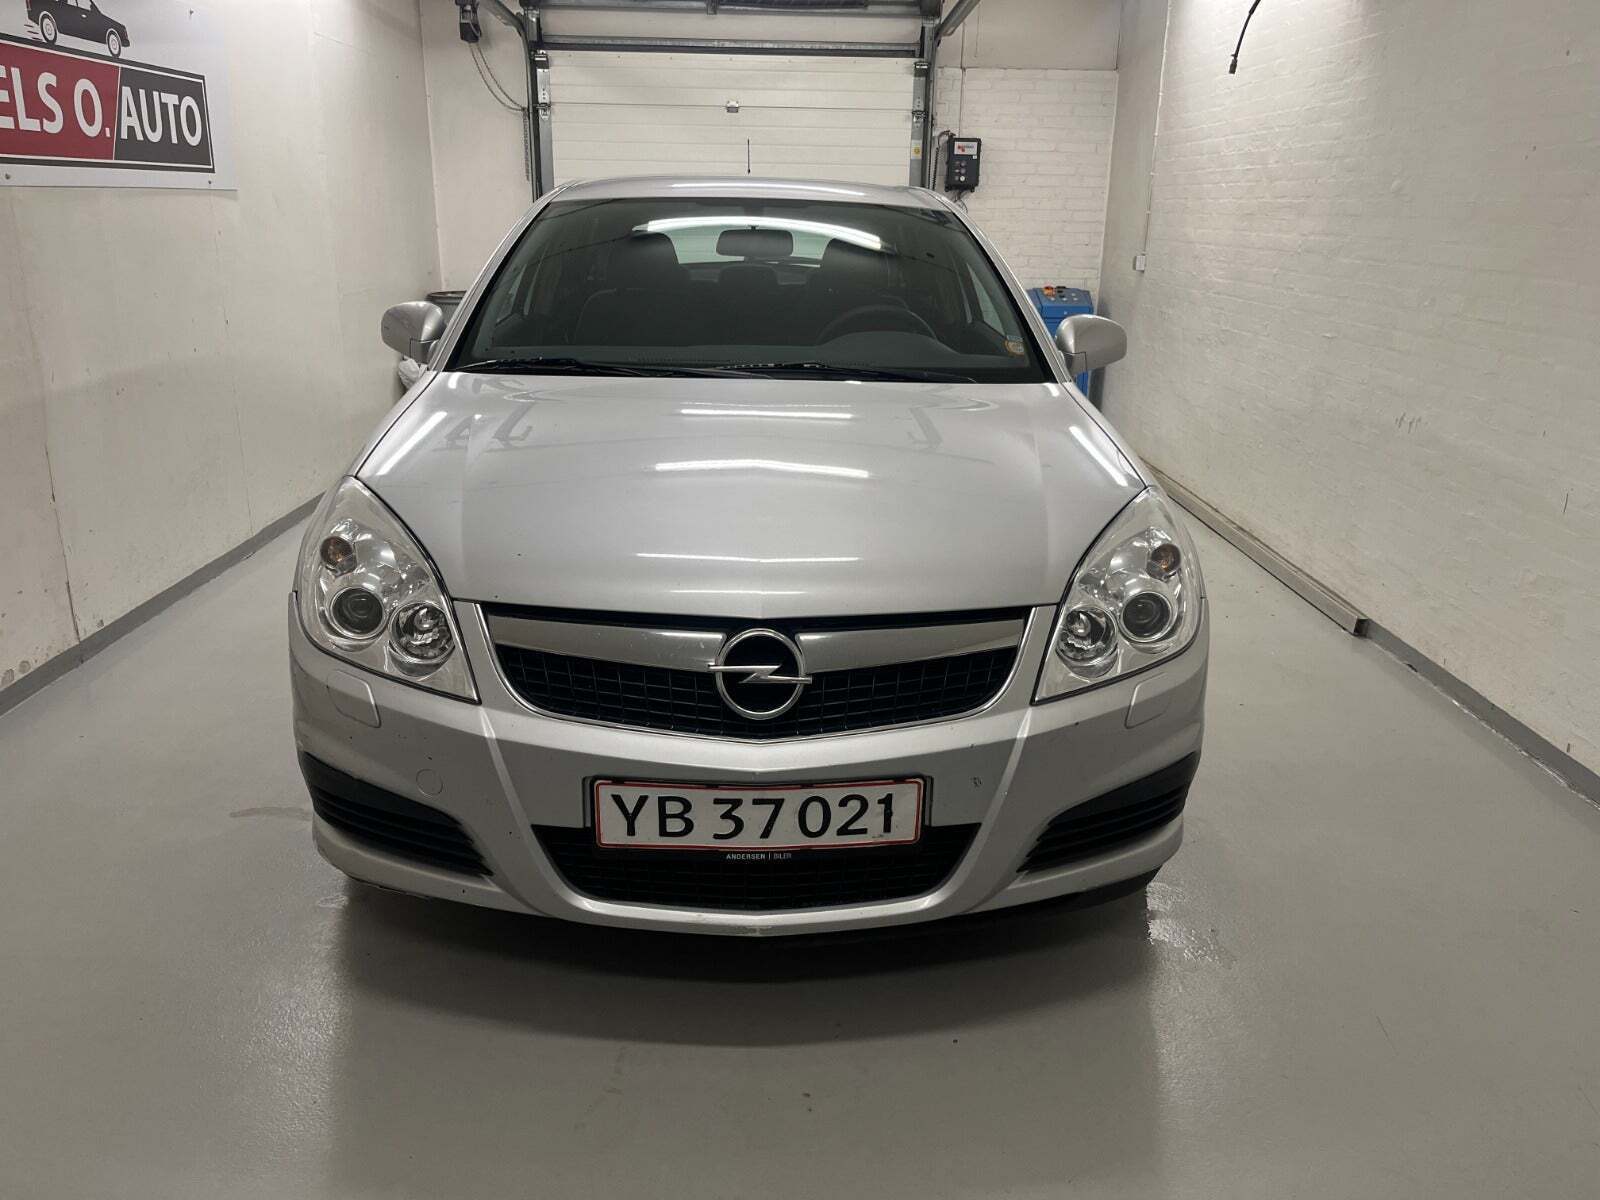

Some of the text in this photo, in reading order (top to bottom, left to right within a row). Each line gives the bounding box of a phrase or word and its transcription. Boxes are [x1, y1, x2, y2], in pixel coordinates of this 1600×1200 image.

[73, 78, 111, 138] O.
[120, 86, 202, 147] AUTO
[611, 794, 694, 838] YB
